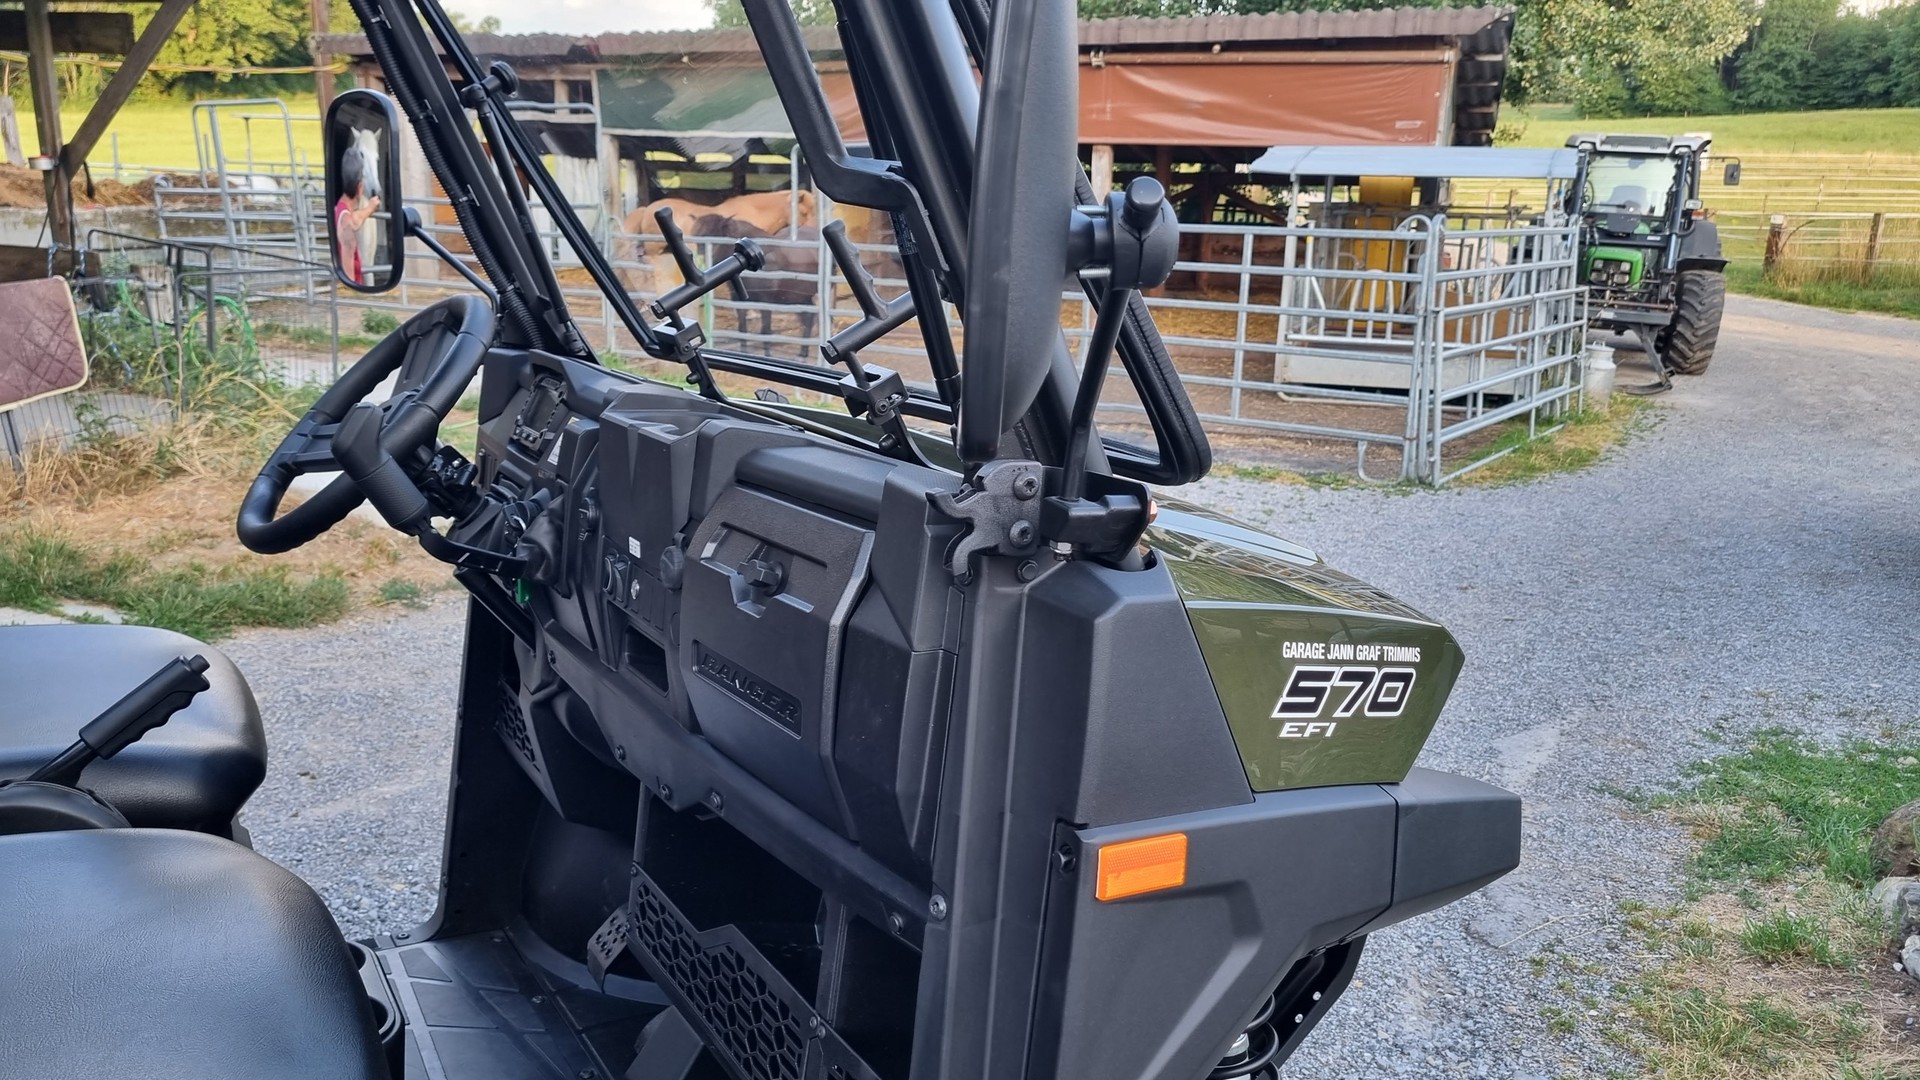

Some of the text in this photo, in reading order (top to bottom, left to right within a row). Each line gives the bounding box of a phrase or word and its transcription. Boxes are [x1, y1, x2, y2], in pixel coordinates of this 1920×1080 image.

[1282, 641, 1421, 663] GARAGE JANN GRAF TRIMMIS
[701, 653, 799, 724] RANGER
[1270, 665, 1416, 718] 570
[1278, 722, 1337, 738] EFI
